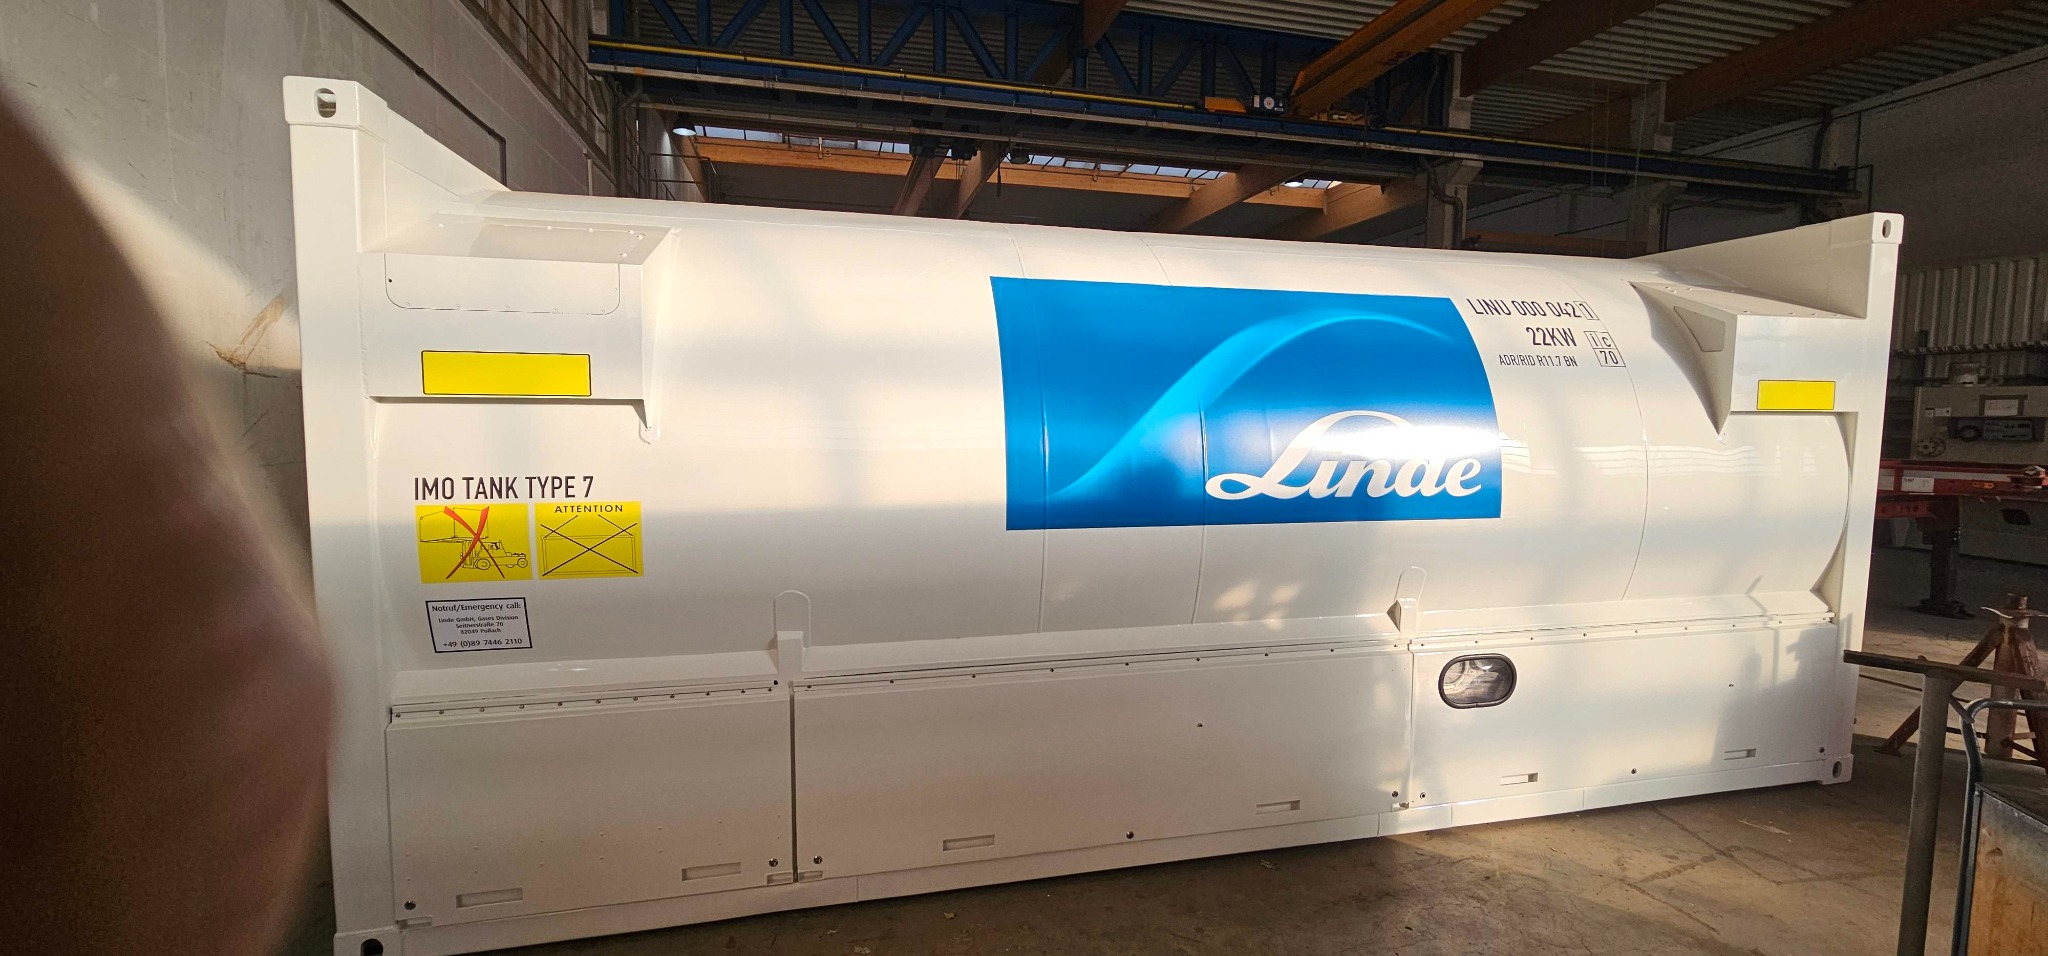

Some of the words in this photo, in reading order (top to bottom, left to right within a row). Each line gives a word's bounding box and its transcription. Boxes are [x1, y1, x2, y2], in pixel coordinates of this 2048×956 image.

[1467, 298, 1512, 316] LINU
[1511, 300, 1546, 317] 000
[1526, 327, 1578, 347] 22KW
[1499, 354, 1536, 367] ADR/RID
[1537, 355, 1562, 367] R11.7
[1563, 355, 1578, 367] BN
[1599, 350, 1619, 365] 70
[1205, 410, 1483, 500] Linde
[414, 477, 455, 500] IMO
[461, 476, 518, 500] TANK
[524, 475, 576, 498] TYPE
[582, 475, 594, 498] 7
[554, 504, 624, 514] ATTENTION
[460, 640, 480, 648] (0)89
